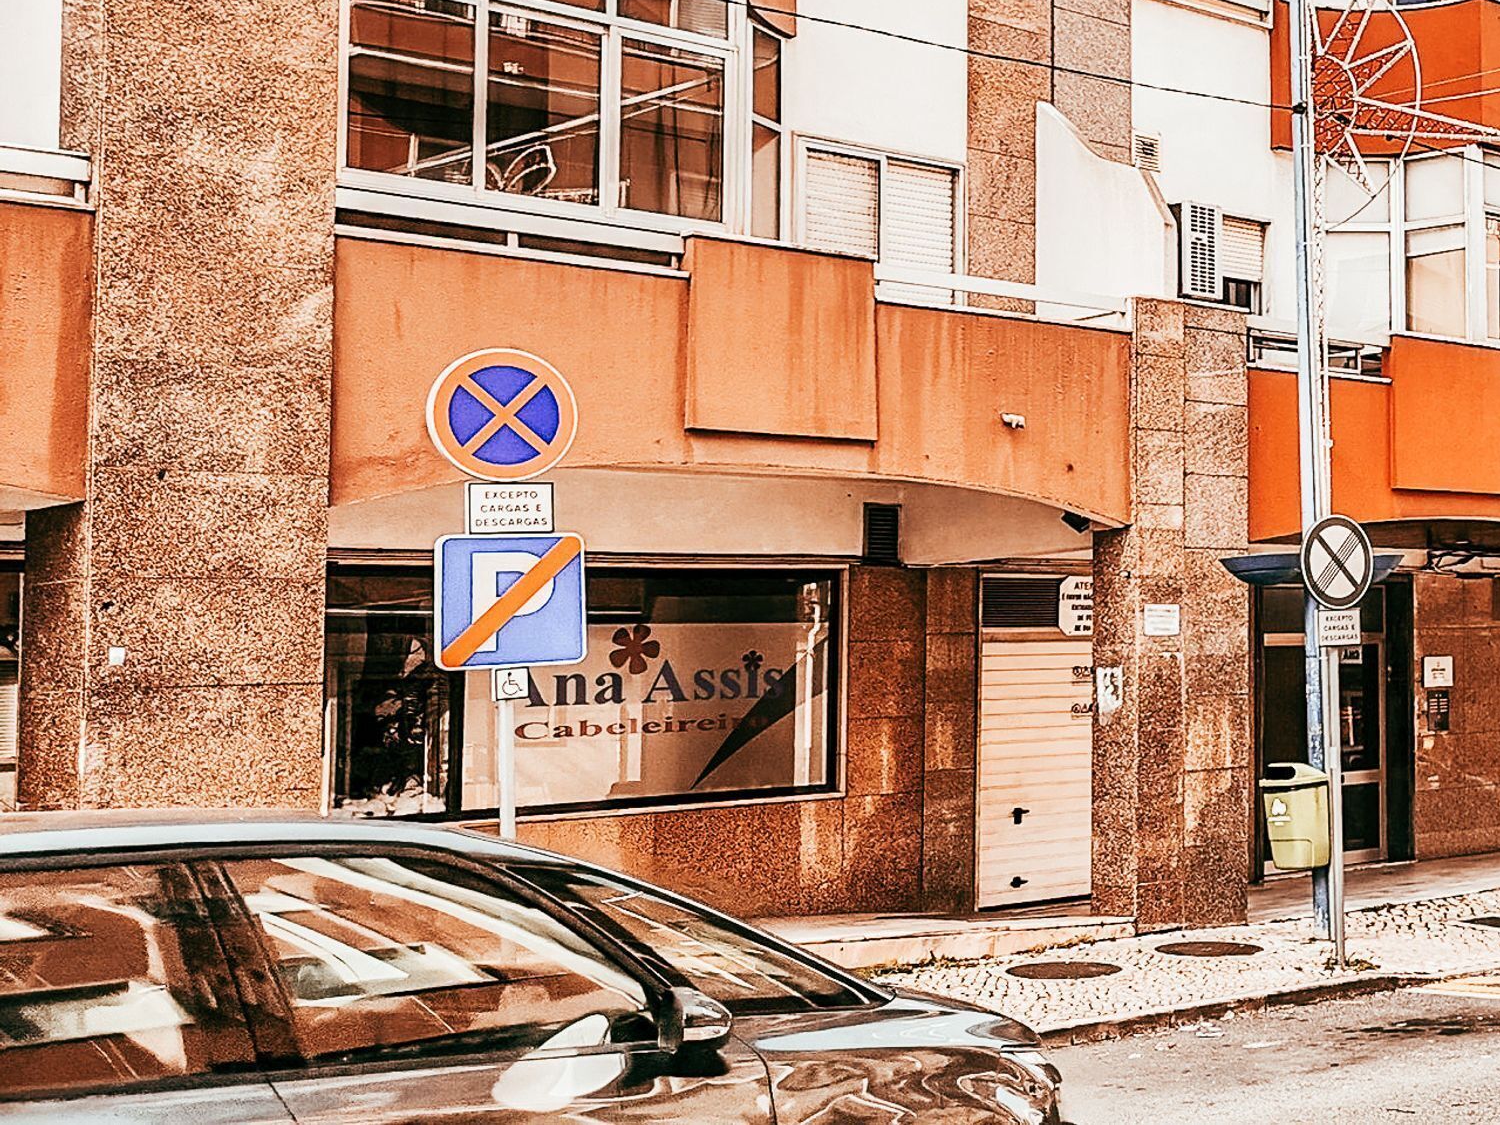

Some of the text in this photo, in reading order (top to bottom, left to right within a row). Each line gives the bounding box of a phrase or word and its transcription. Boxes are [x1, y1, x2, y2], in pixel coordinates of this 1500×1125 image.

[485, 490, 538, 499] EXCEPTO
[480, 503, 542, 513] CARGAS E
[475, 517, 548, 527] DESCARGAS
[471, 551, 555, 653] P
[641, 657, 785, 703] Assis
